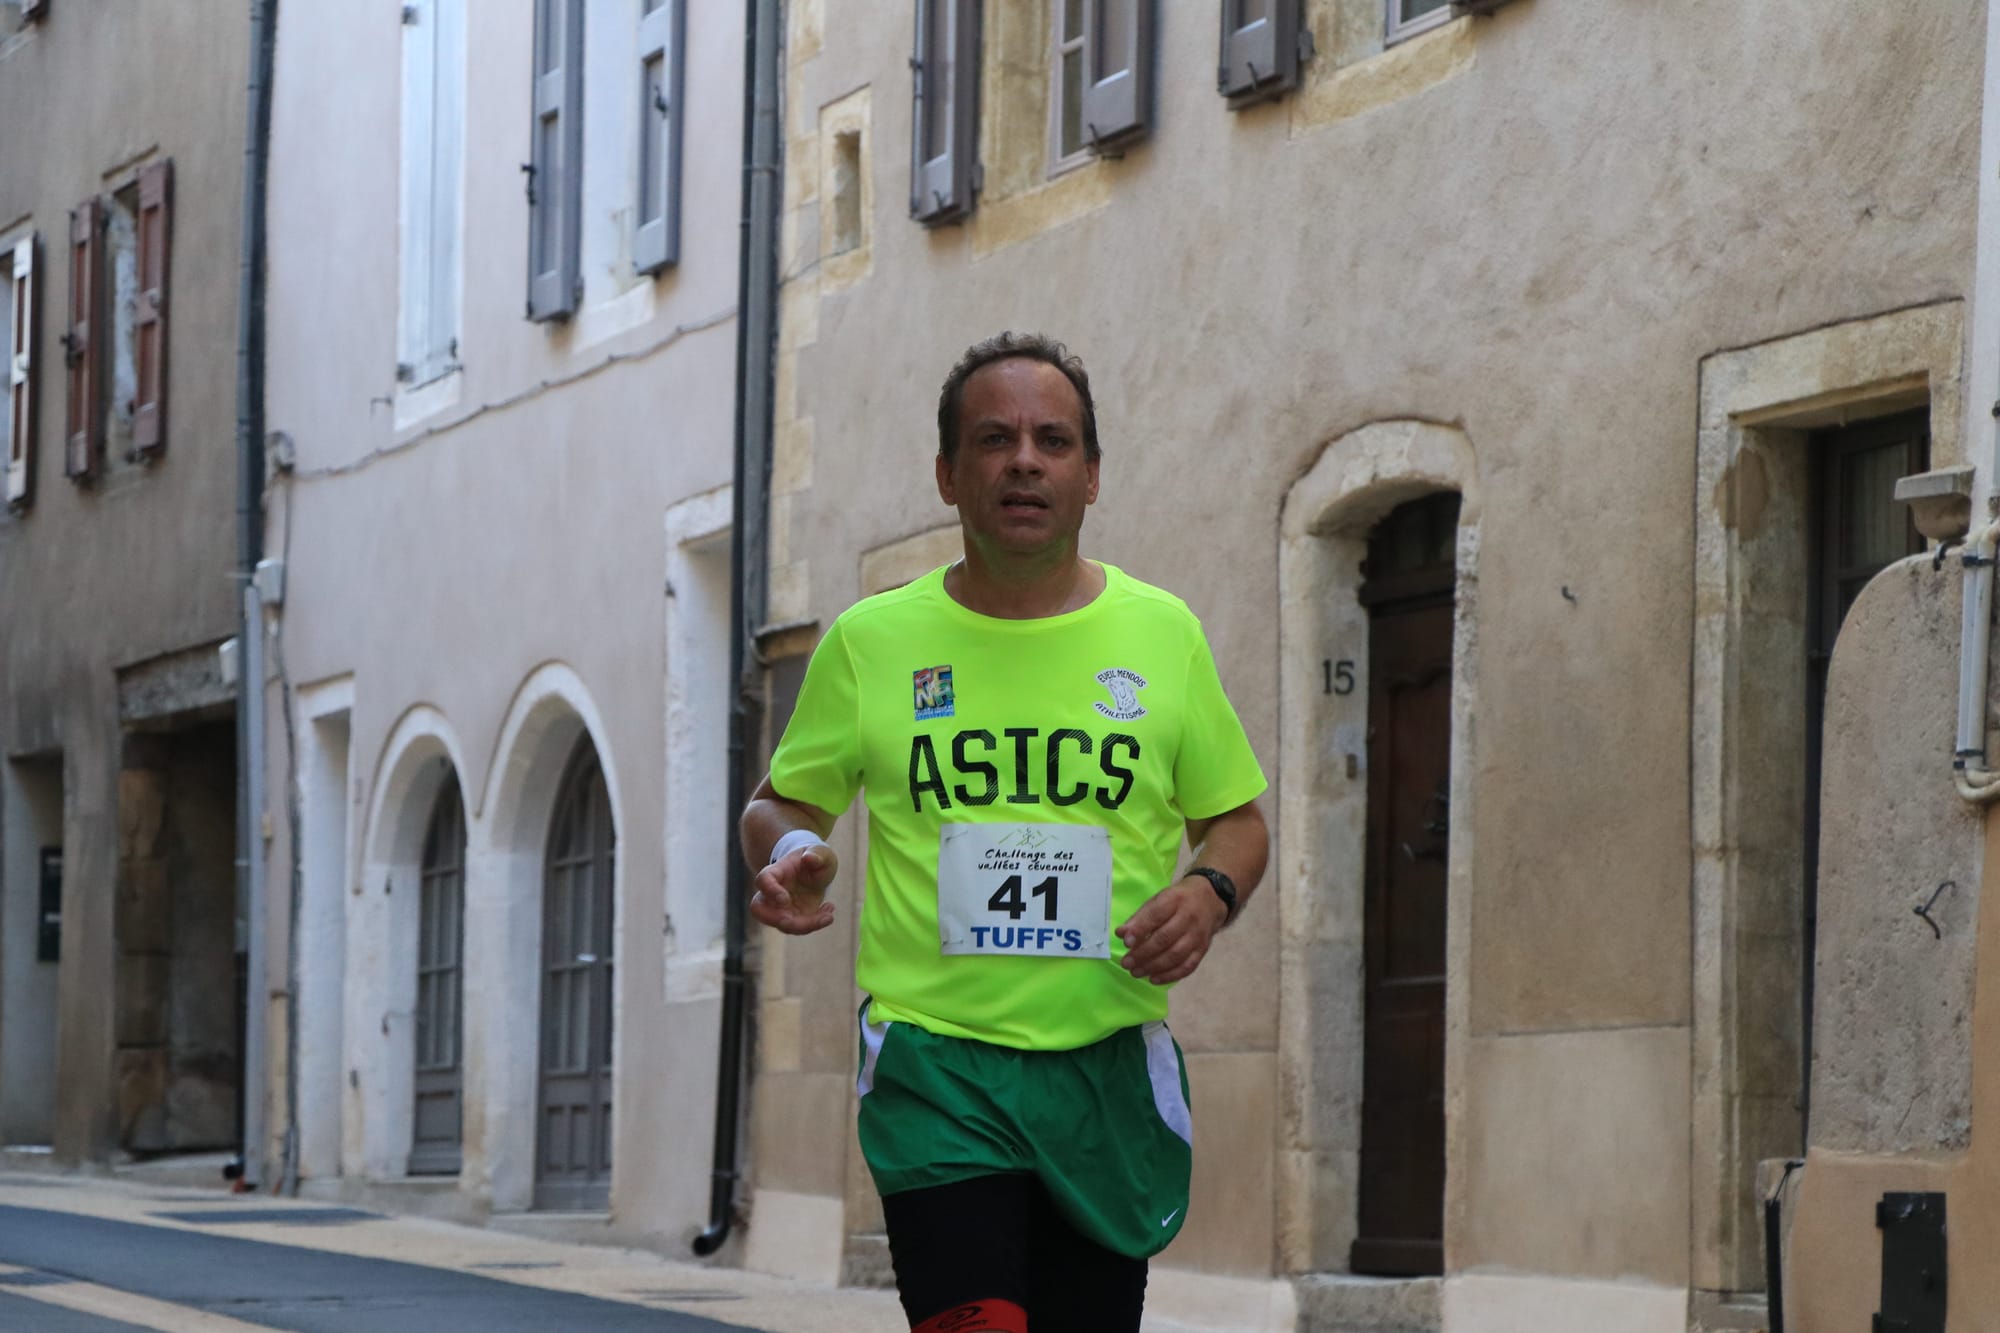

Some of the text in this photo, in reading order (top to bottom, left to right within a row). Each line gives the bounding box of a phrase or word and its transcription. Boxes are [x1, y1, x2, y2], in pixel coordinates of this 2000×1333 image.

[1322, 658, 1355, 696] 15
[1095, 703, 1146, 720] ATHLETISME
[909, 728, 1140, 813] ASICS
[978, 860, 1079, 872] vallées cévenoles
[985, 849, 1074, 863] Challenge des
[988, 875, 1058, 921] 41
[970, 926, 1082, 951] TUFF'S
